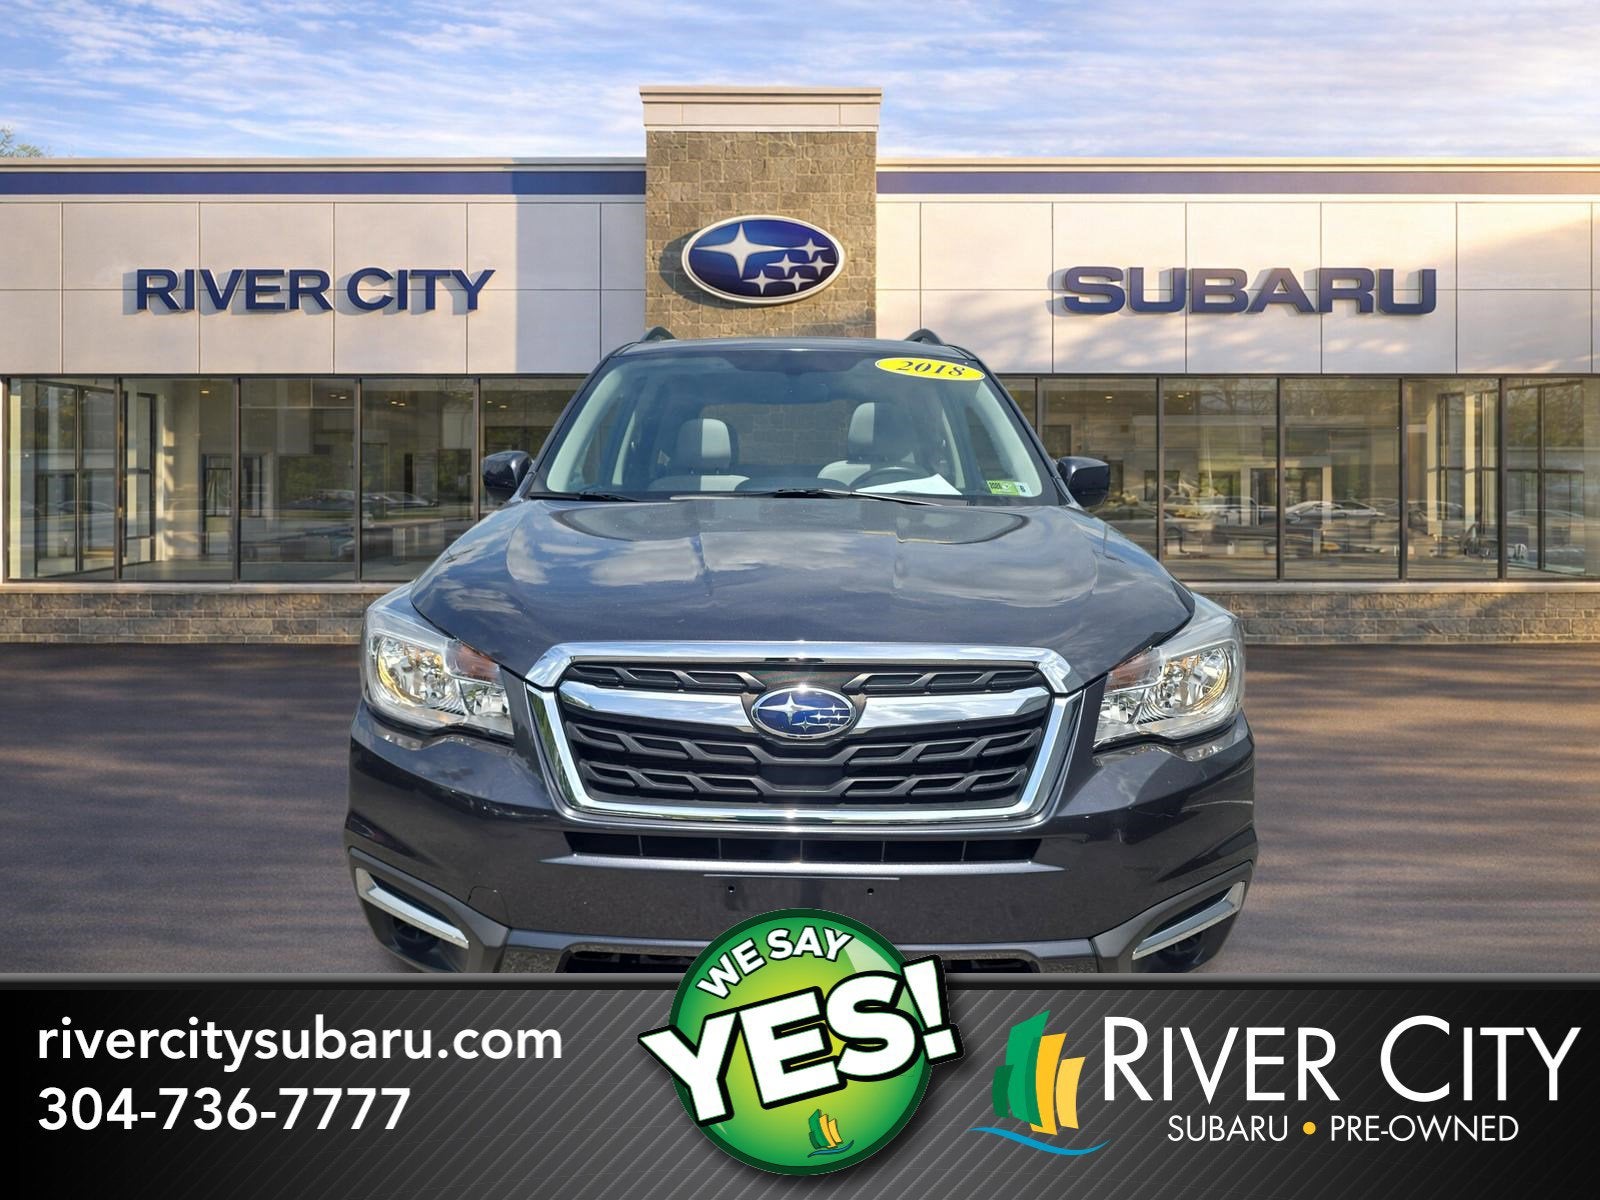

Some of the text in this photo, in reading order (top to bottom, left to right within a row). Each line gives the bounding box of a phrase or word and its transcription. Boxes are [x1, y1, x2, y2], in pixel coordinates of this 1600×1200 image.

[136, 267, 496, 311] RIVER CITY
[1062, 266, 1437, 315] SUBARU
[896, 361, 965, 377] 2018
